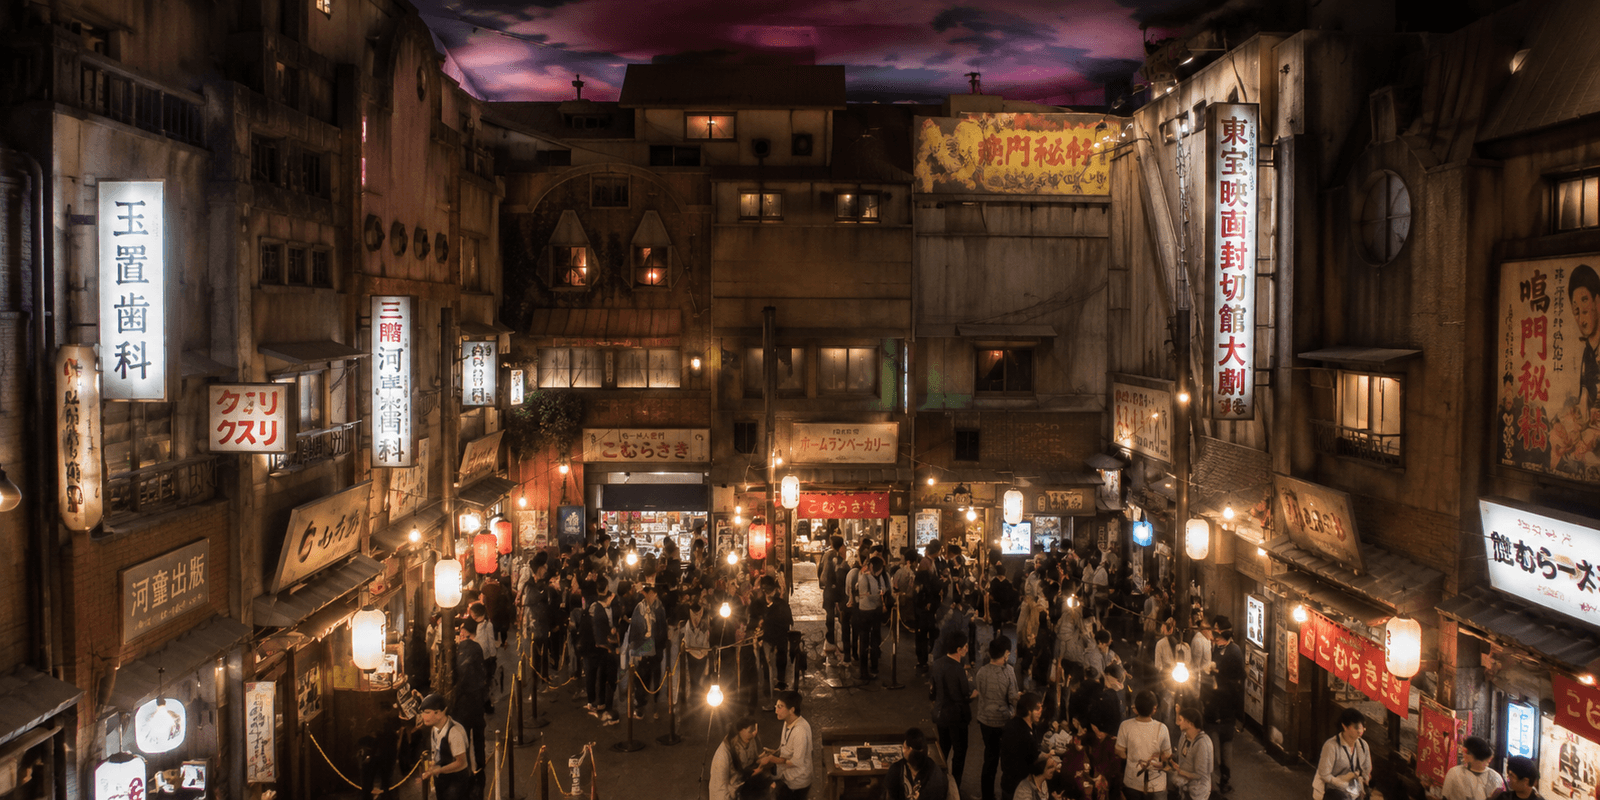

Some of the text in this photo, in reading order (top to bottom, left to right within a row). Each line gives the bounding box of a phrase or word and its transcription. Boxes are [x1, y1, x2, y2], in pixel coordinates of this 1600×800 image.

[113, 200, 151, 381] 玉置歯科
[217, 419, 278, 446] クスリ
[800, 436, 891, 452] ホームランベーカリー
